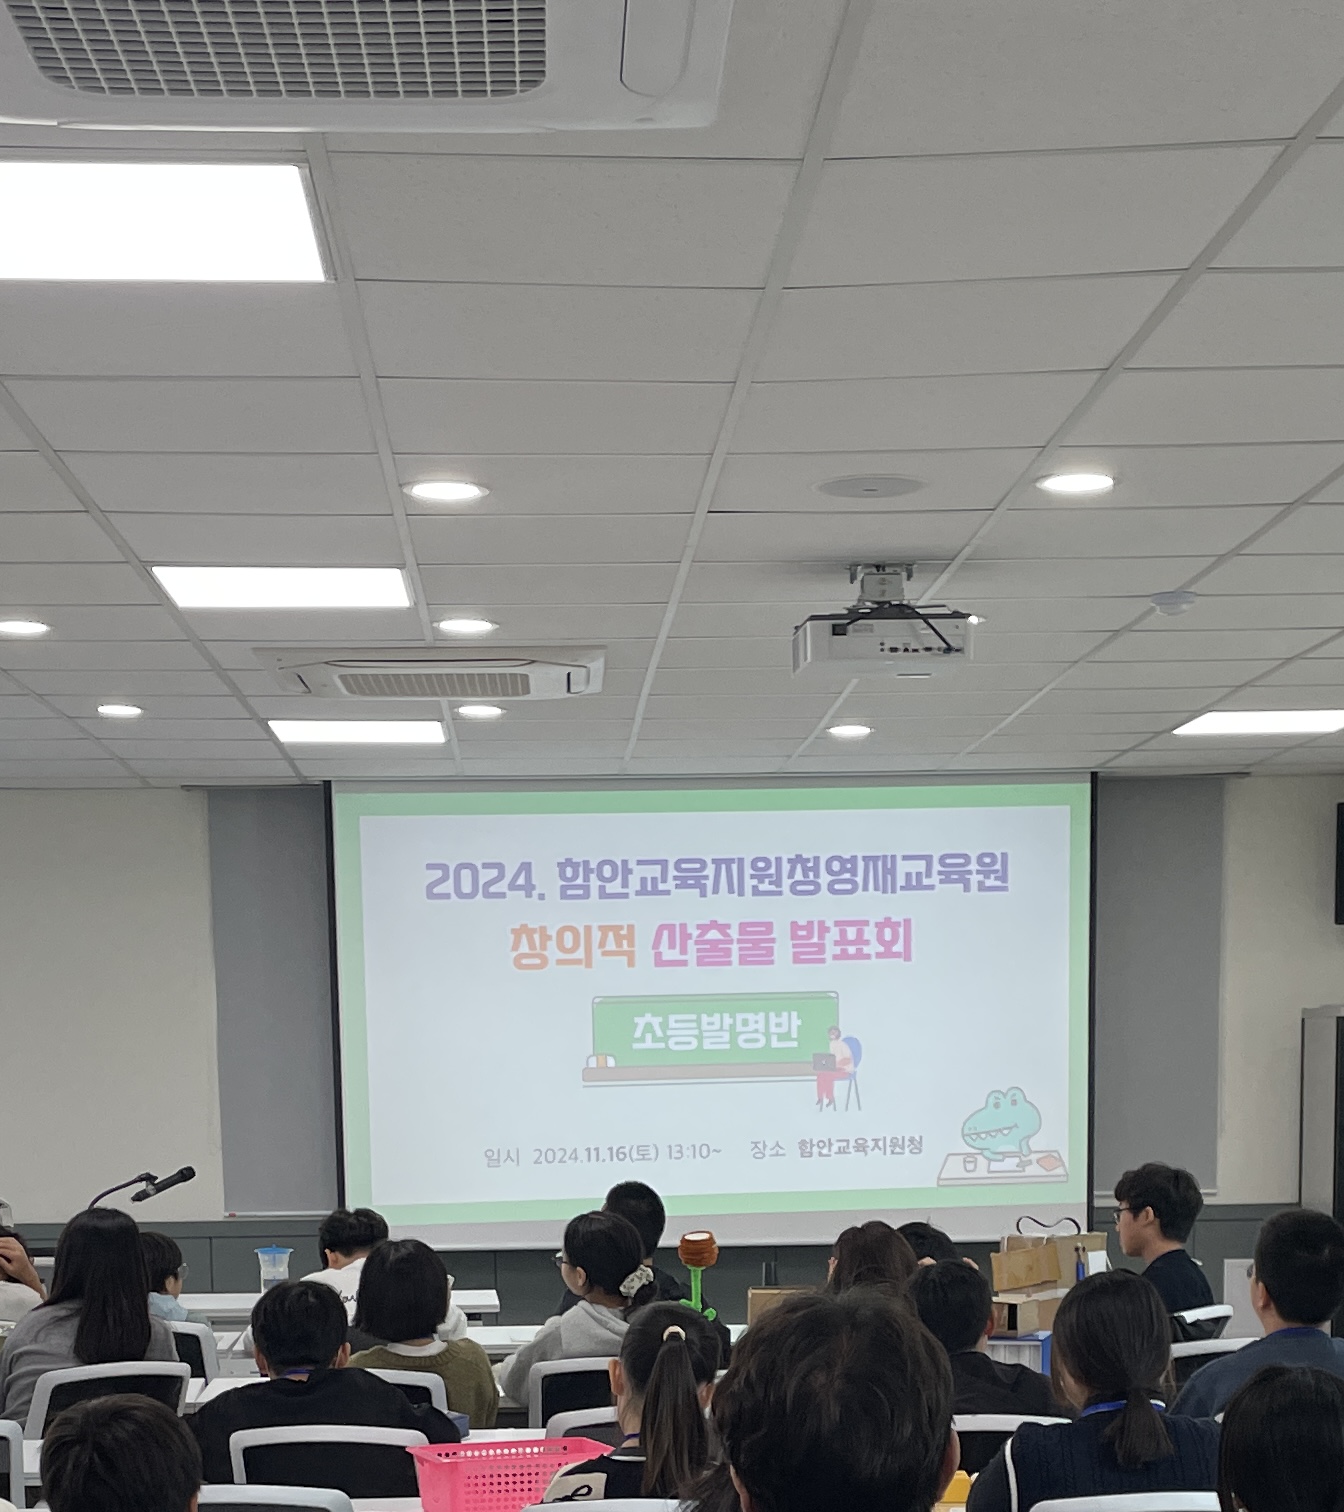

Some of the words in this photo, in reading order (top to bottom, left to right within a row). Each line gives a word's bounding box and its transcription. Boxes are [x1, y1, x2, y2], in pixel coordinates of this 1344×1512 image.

[424, 861, 548, 901] 2024.
[557, 852, 1010, 900] 함안교육지원청영재교육원
[509, 923, 637, 970] 창의적
[650, 920, 777, 967] 산출물
[789, 917, 914, 964] 발표회
[631, 1012, 803, 1051] 초등발명반
[483, 1146, 521, 1169] 일시
[532, 1142, 660, 1166] 2024.11.16(토)
[666, 1142, 723, 1161] 13:10~
[750, 1138, 786, 1160] 장소
[797, 1136, 924, 1159] 함안교육지원청
